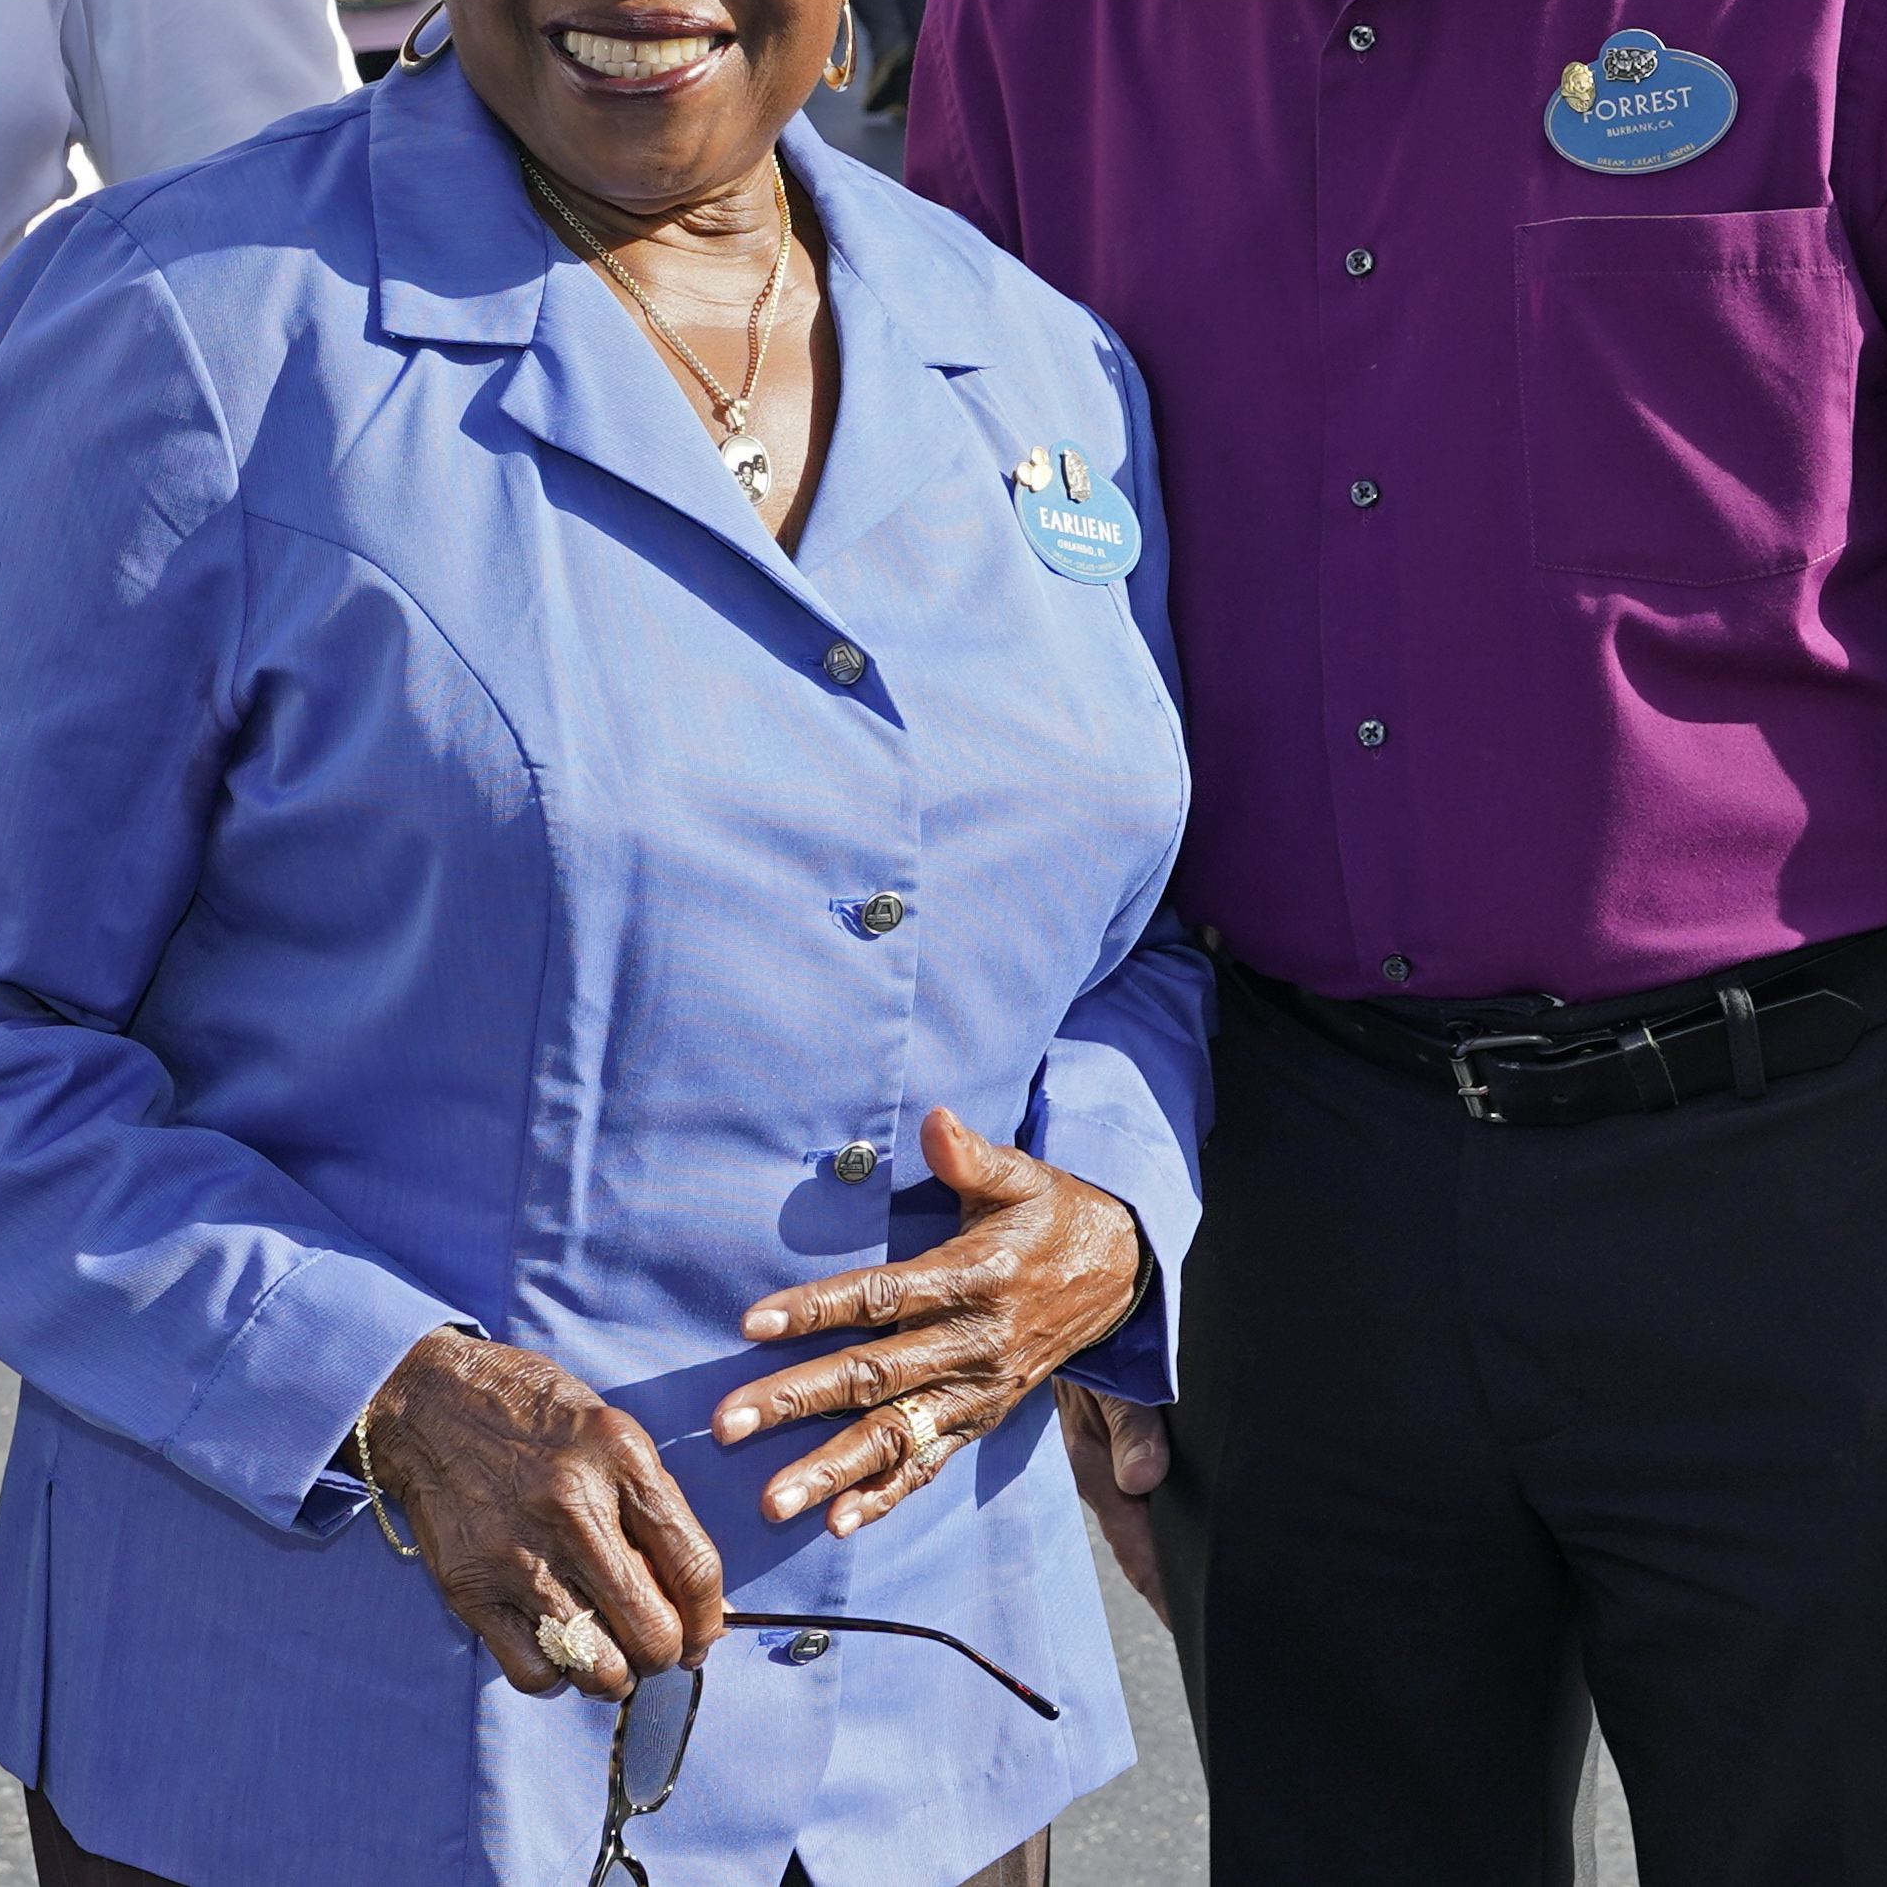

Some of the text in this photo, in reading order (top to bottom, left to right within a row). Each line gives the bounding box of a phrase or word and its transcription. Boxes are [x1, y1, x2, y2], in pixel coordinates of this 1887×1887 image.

[1606, 119, 1674, 137] BURBANK, CA
[1039, 506, 1123, 545] EARLIENE
